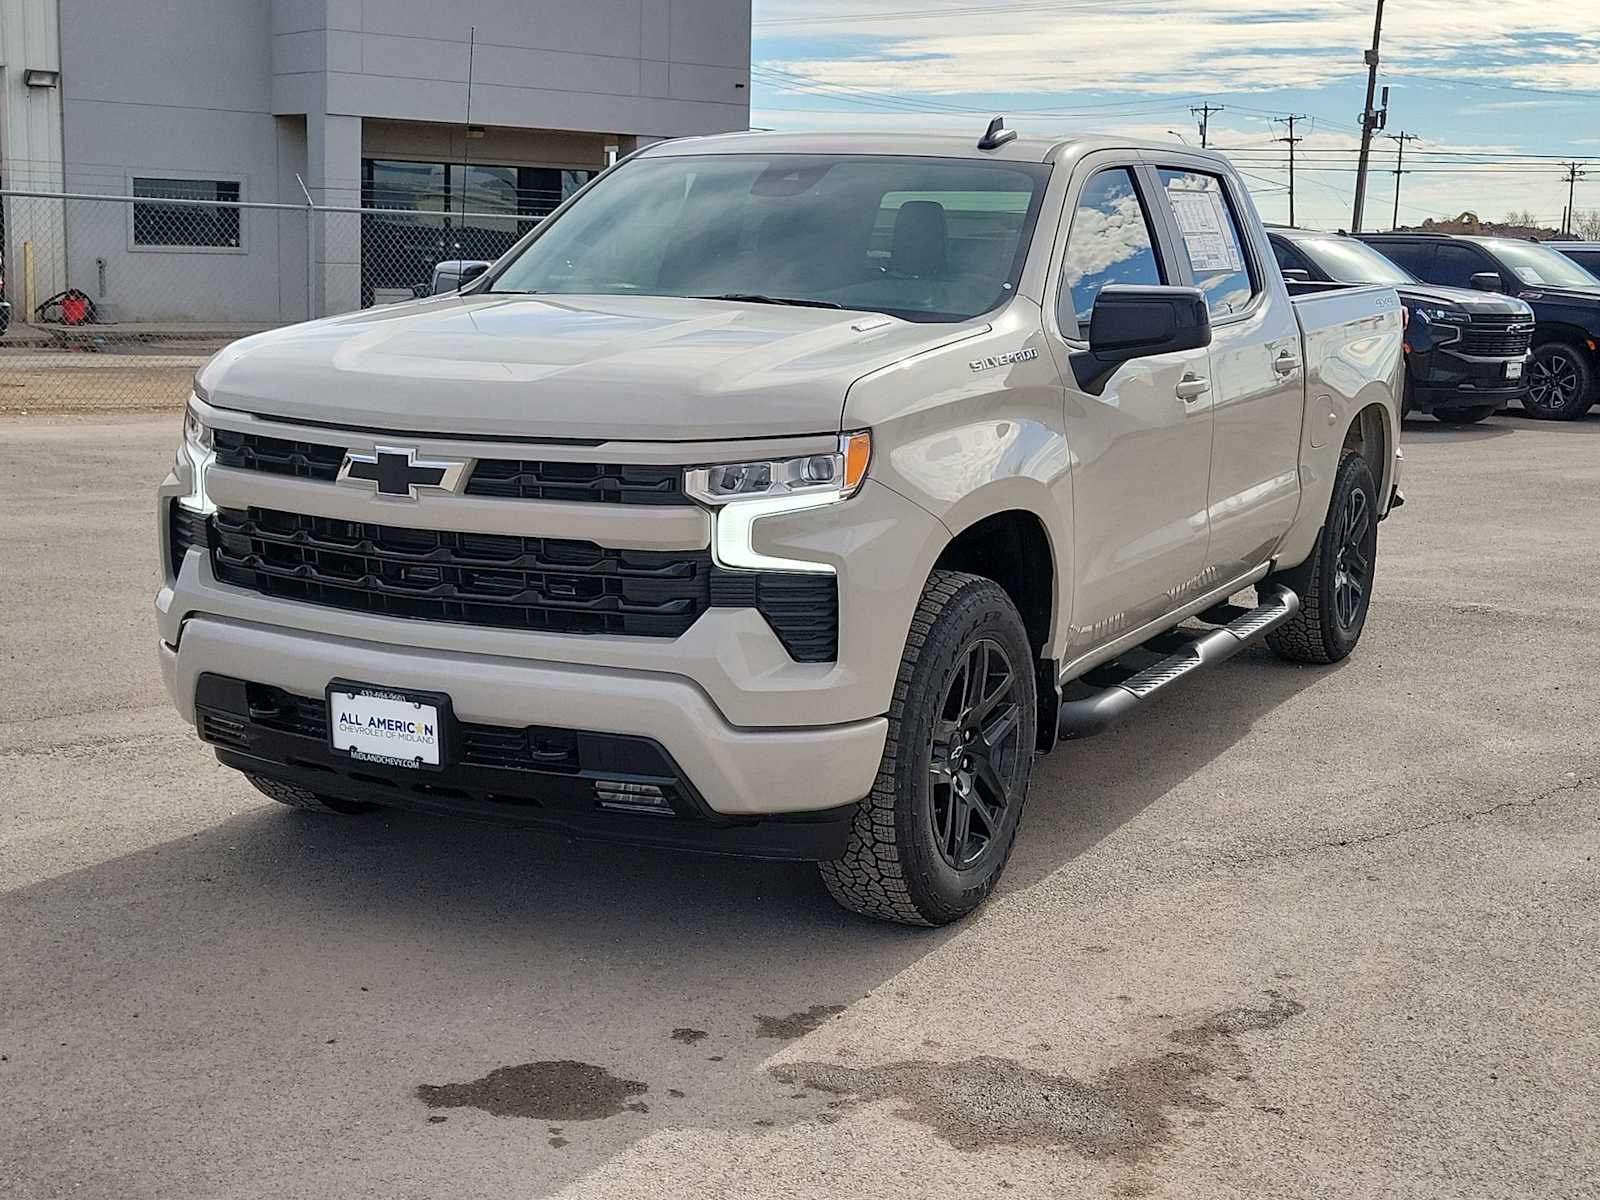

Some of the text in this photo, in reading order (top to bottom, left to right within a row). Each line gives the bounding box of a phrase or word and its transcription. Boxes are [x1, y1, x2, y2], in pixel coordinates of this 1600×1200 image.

[969, 347, 1038, 372] SILVERADO
[339, 712, 362, 726] ALL
[339, 723, 435, 745] CHEVROLET OF MIDLAND
[350, 750, 420, 769] MIDLANDCHEVY.COM
